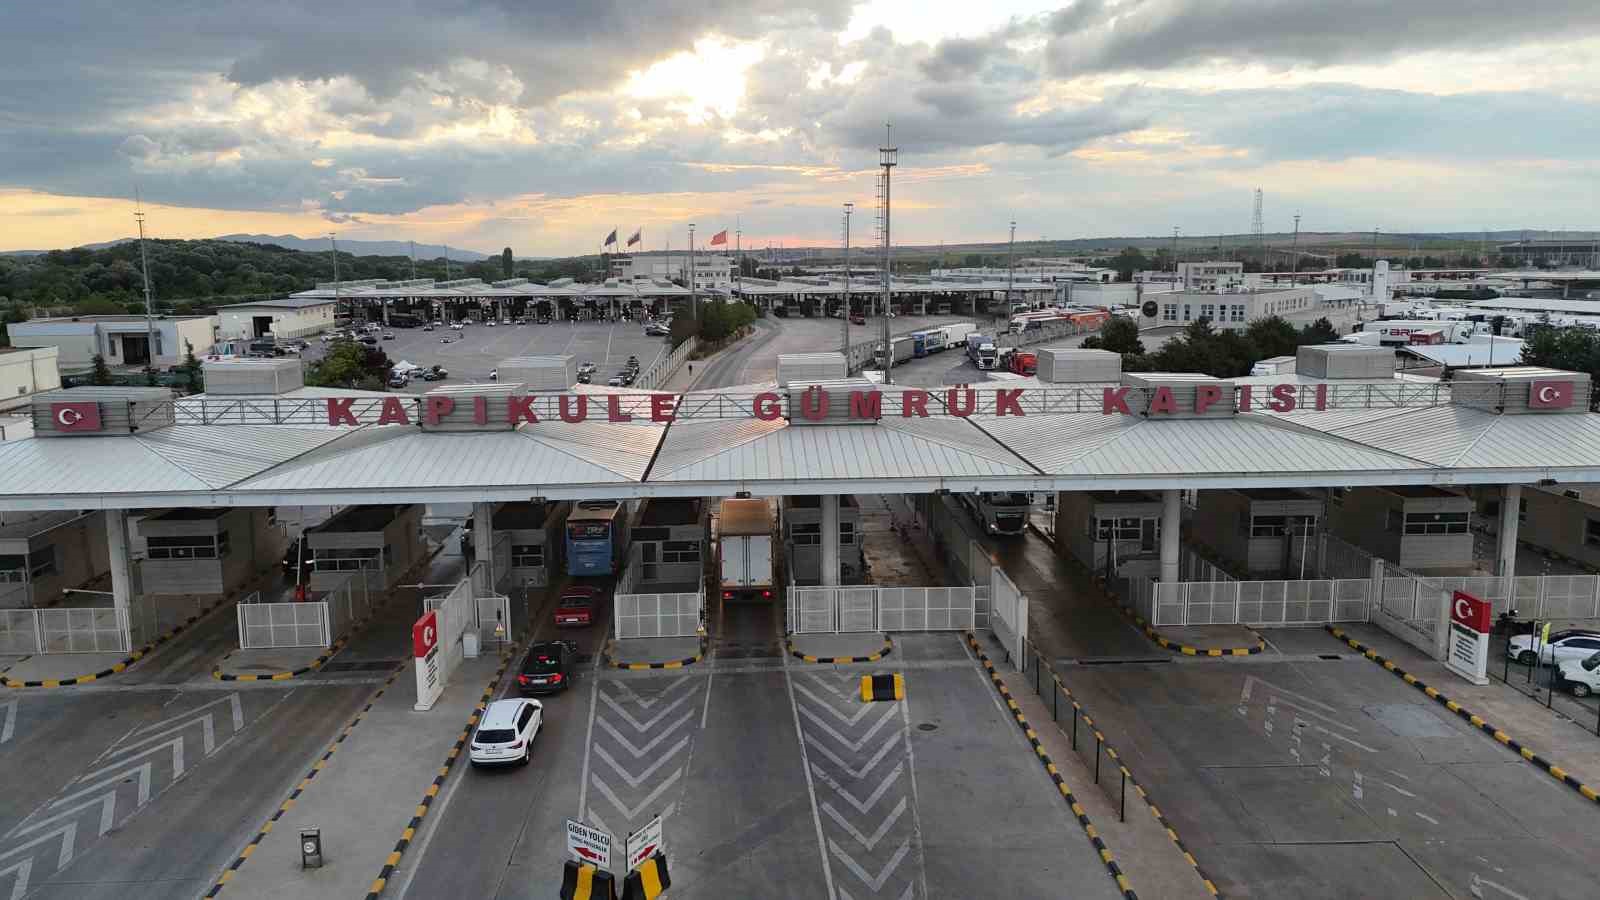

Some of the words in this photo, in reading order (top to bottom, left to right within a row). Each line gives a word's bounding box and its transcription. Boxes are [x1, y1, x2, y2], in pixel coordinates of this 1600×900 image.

[327, 394, 676, 427] KAPIKULE
[752, 383, 1025, 421] GÜMRÜK
[1102, 383, 1328, 415] KAPISI
[588, 831, 610, 846] YOLCU
